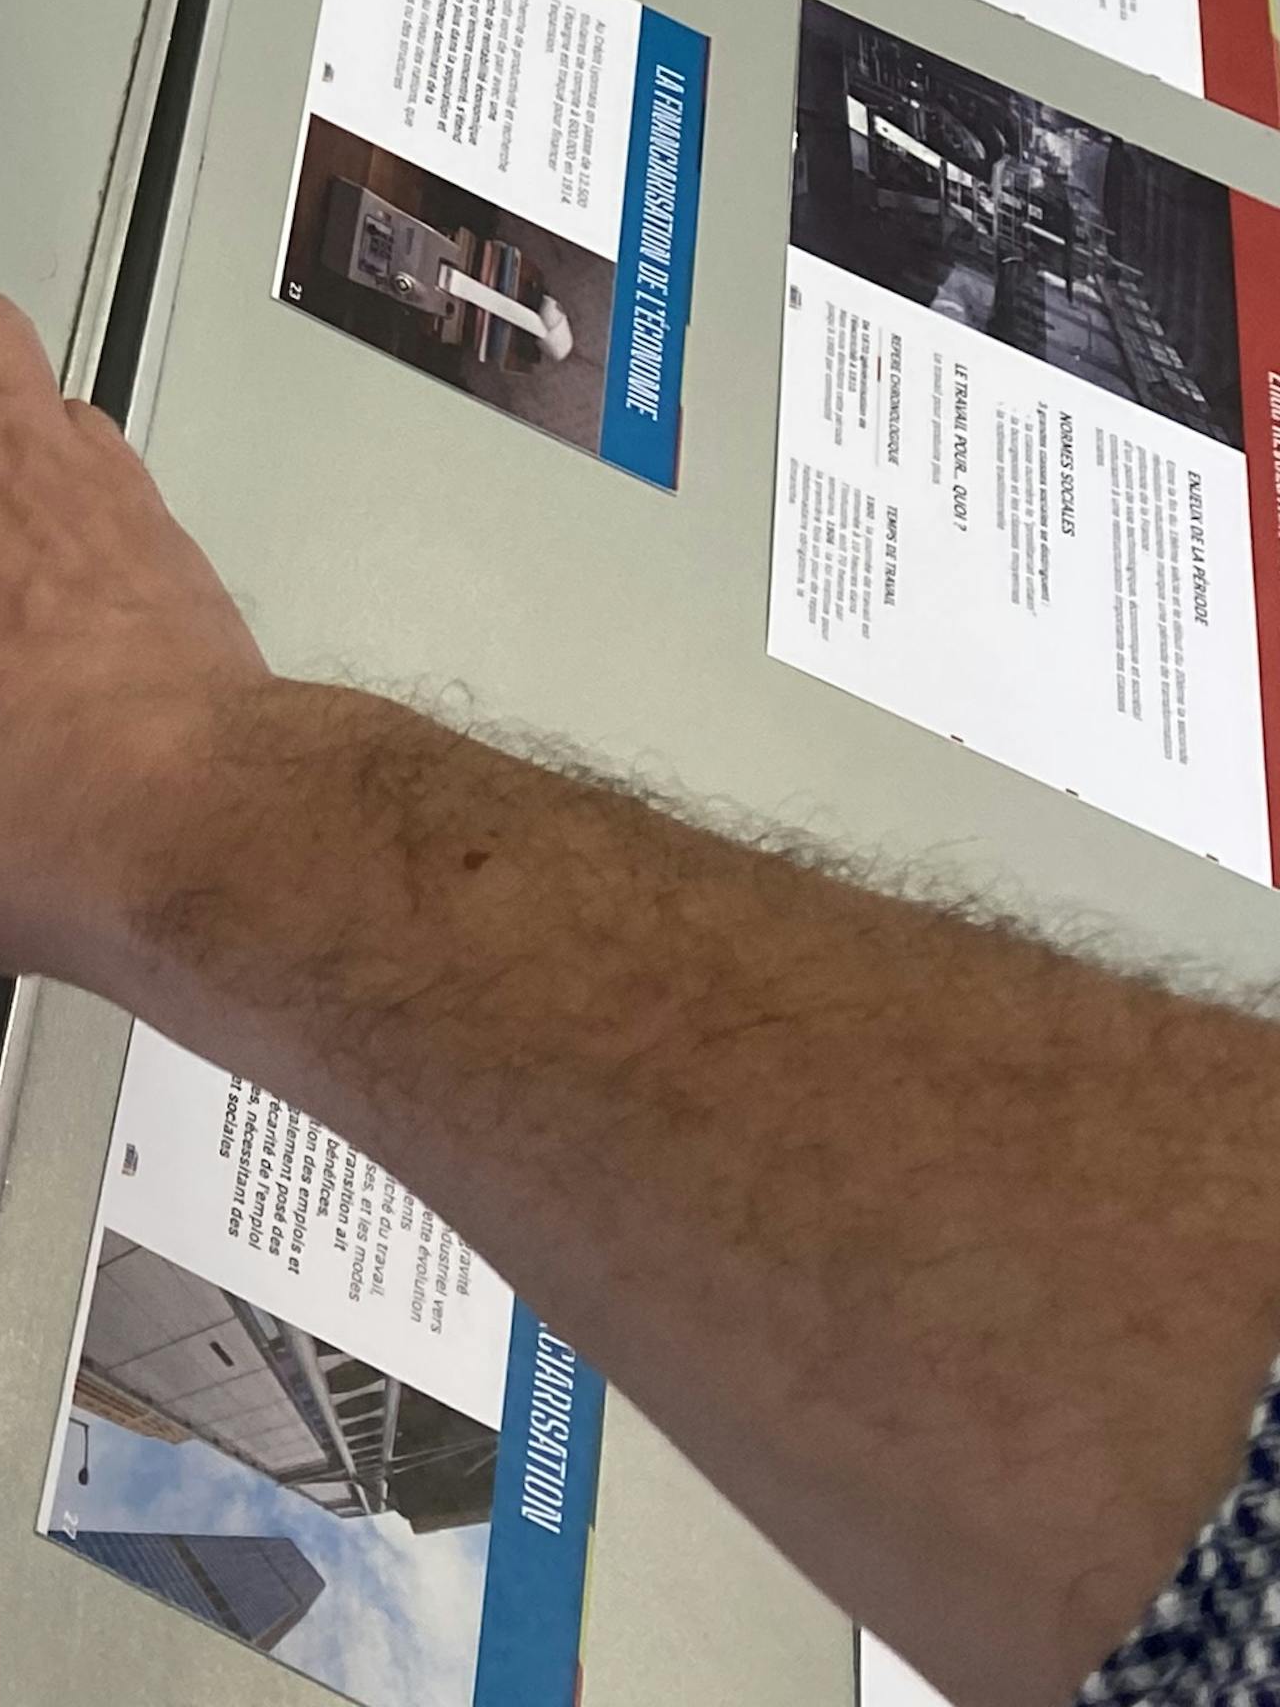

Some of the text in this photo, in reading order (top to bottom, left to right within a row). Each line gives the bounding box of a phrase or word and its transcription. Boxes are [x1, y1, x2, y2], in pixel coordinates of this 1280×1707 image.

[624, 63, 686, 422] LA FINANCIARISATION DE L'ÉCONOMIE
[287, 280, 302, 301] 23
[953, 361, 968, 381] LE
[953, 380, 968, 432] TRAVAIL
[886, 372, 901, 466] CHRONOLOGIQUE
[951, 483, 967, 521] QUOI
[1058, 410, 1075, 537] NORMES SOCIALES
[882, 504, 898, 606] TEMPS DE TRAVAIL
[953, 521, 968, 532] ?
[1187, 469, 1208, 627] ENJEUX DE LA PÉRIODE
[218, 1091, 239, 1159] sociales
[227, 1109, 258, 1238] nécessitant des
[247, 1157, 274, 1251] de l'emploi
[286, 1153, 316, 1275] des emplois et
[315, 1137, 341, 1217] bénéfices,
[267, 1180, 289, 1256] posé des
[347, 1196, 372, 1302] et les modes
[369, 1215, 393, 1296] du travail,
[409, 1243, 431, 1323] évolution
[429, 1298, 444, 1335] vers
[520, 1321, 575, 1534] CIARISATION
